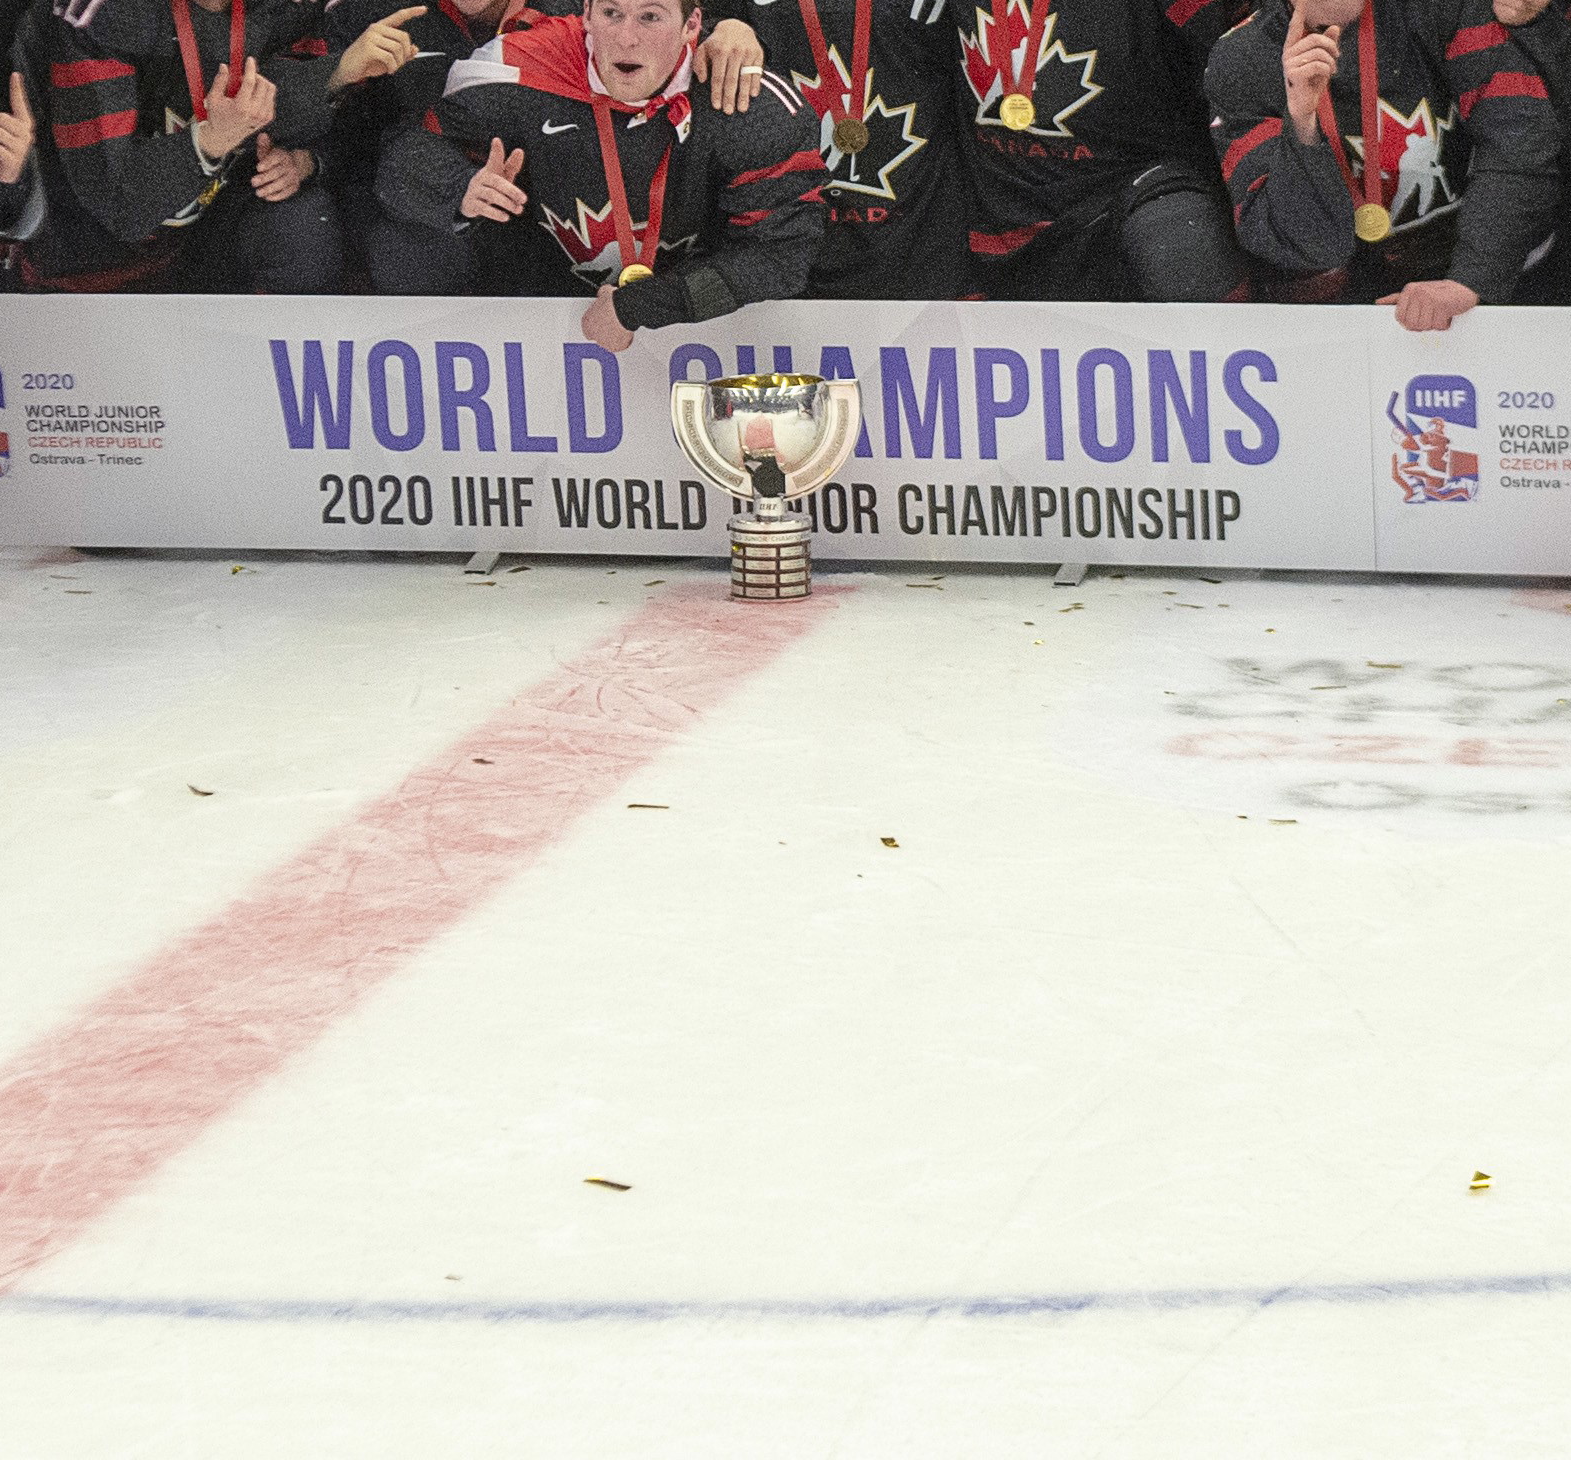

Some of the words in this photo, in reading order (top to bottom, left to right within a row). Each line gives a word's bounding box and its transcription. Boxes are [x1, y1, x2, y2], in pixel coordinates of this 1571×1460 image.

[22, 373, 74, 390] 2020
[269, 340, 623, 454] WORLD
[1415, 390, 1467, 408] IIHF
[1497, 391, 1555, 409] 2020
[25, 405, 89, 418] WORLD
[94, 405, 161, 419] JUNIOR
[26, 419, 165, 433] CHAMPIONSHIP
[1499, 424, 1569, 439] WORLD
[28, 436, 81, 448] CZECH
[85, 436, 163, 449] REPUBLIC
[29, 453, 85, 465] Ostrava
[97, 454, 143, 466] Trinec
[1500, 458, 1558, 472] CZECH
[1500, 476, 1561, 489] Ostrava
[320, 474, 433, 525] 2020
[453, 476, 534, 528] IIHF
[552, 478, 707, 531] WORLD
[898, 482, 1241, 541] CHAMPIONSHIP
